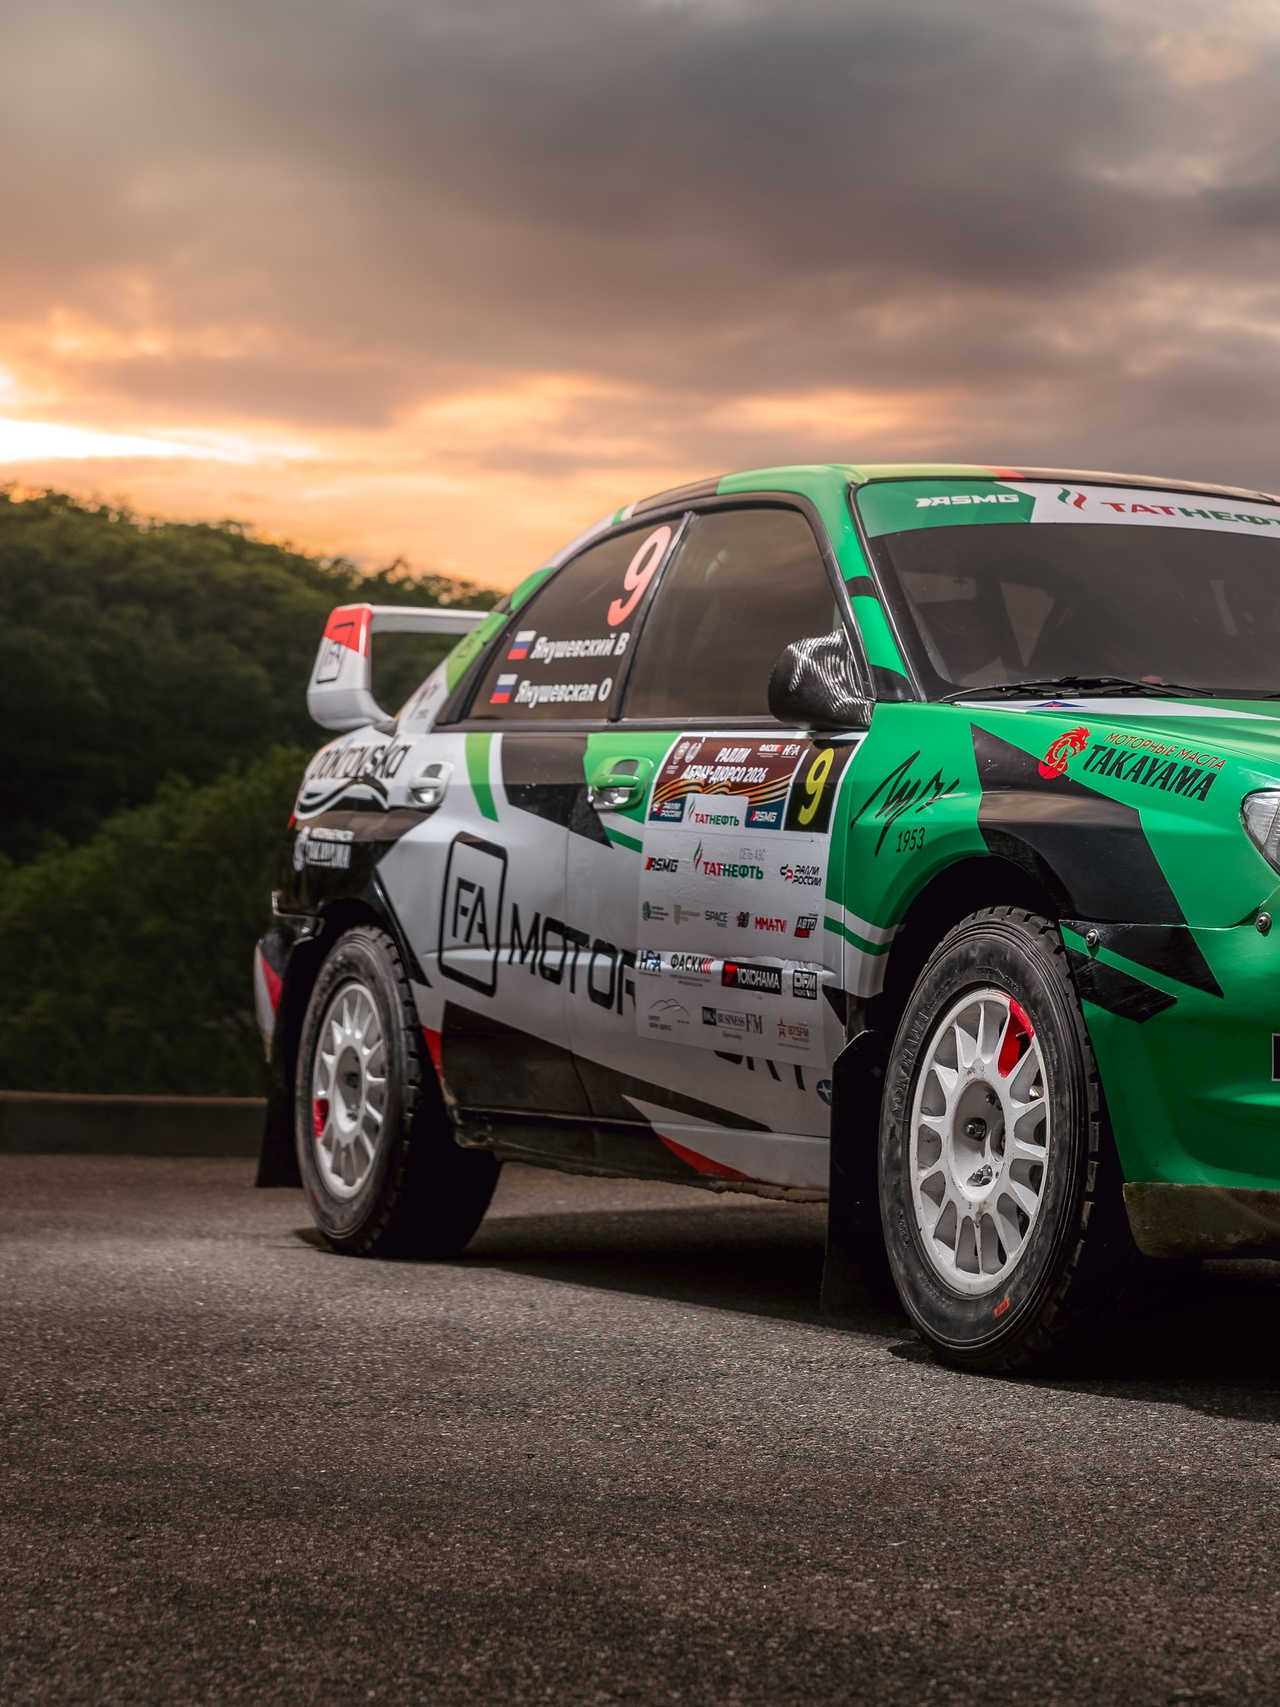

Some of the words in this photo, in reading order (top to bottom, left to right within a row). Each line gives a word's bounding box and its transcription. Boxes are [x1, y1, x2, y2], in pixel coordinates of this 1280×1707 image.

[607, 525, 672, 626] 9
[530, 632, 616, 664] Янушевский
[514, 680, 598, 709] Янушевская
[1103, 732, 1178, 757] МОТОРНЫЕ
[1173, 748, 1227, 771] МАСЛА
[742, 767, 769, 784] 2026
[1083, 744, 1218, 802] TAKAYAMA
[797, 748, 835, 825] 9
[695, 813, 739, 826] ТАТНЕФТЬ
[896, 827, 926, 853] 1953
[703, 861, 763, 880] ТАТНЕФТЬ
[452, 876, 491, 952] FA
[704, 910, 728, 922] SPACE
[736, 967, 780, 989] YOKOHAMA
[794, 972, 816, 989] DFM
[717, 1013, 745, 1026] BUSINESS
[746, 1012, 763, 1034] FM
